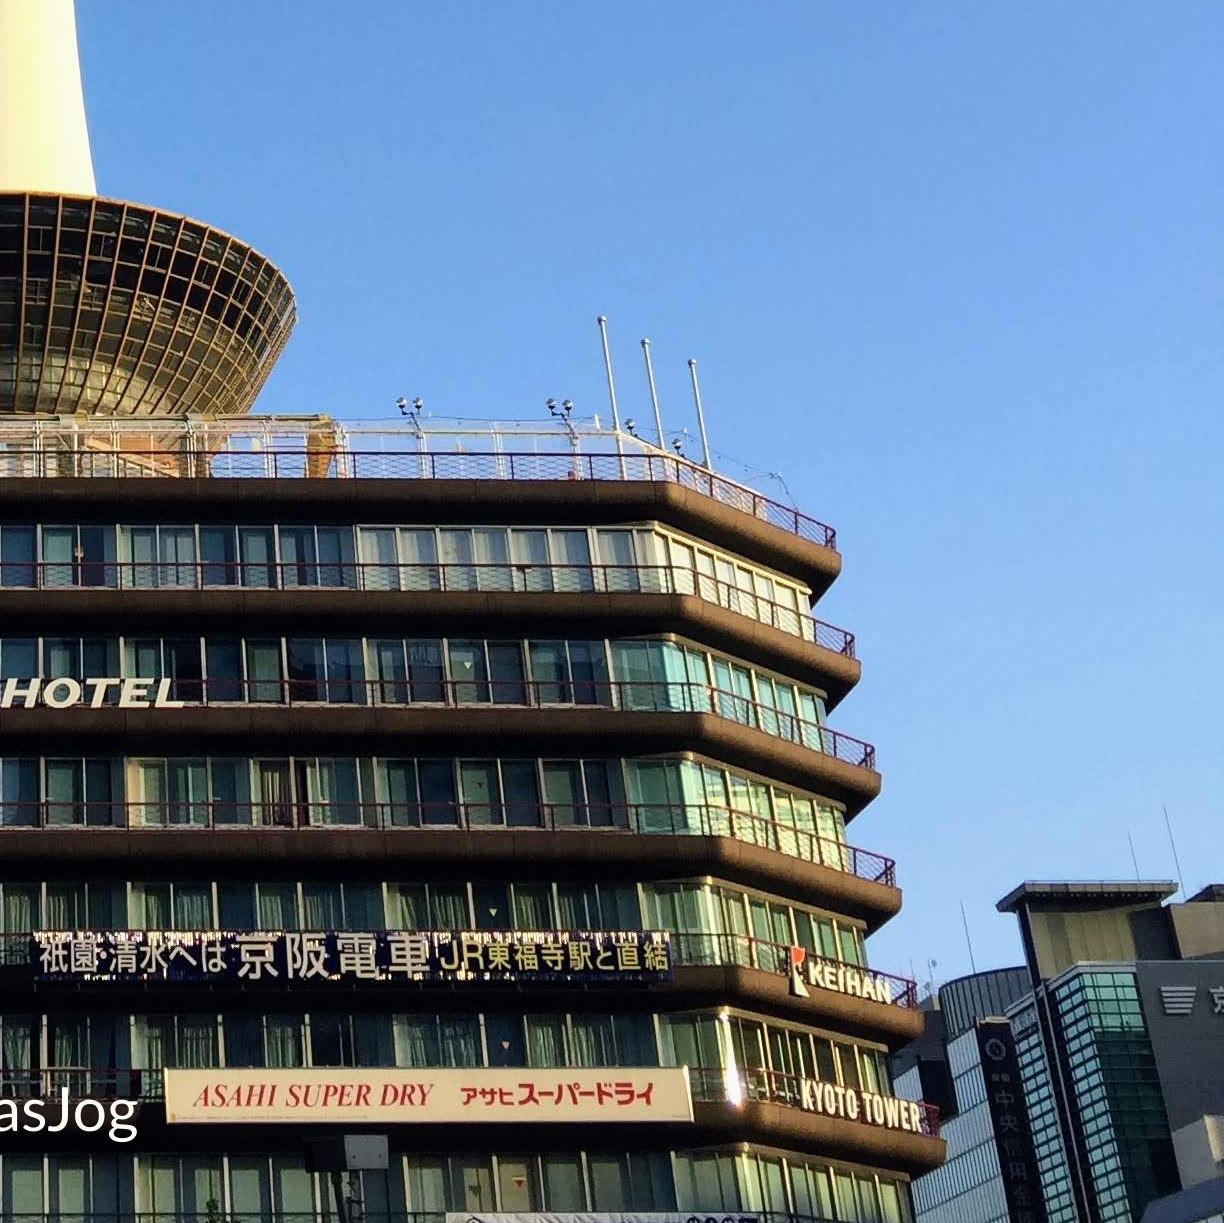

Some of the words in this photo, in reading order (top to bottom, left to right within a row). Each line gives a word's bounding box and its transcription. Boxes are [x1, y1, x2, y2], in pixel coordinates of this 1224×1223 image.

[0, 677, 185, 709] HOTEL
[235, 932, 431, 979] 京阪電車
[440, 939, 669, 972] JR東福寺駅と直結
[808, 961, 892, 1005] KEIHAN
[193, 1083, 278, 1108] ASAHI
[285, 1083, 372, 1109] SUPER
[380, 1082, 434, 1108] DRY
[801, 1078, 859, 1121] KYOTO
[862, 1091, 923, 1134] TOWER
